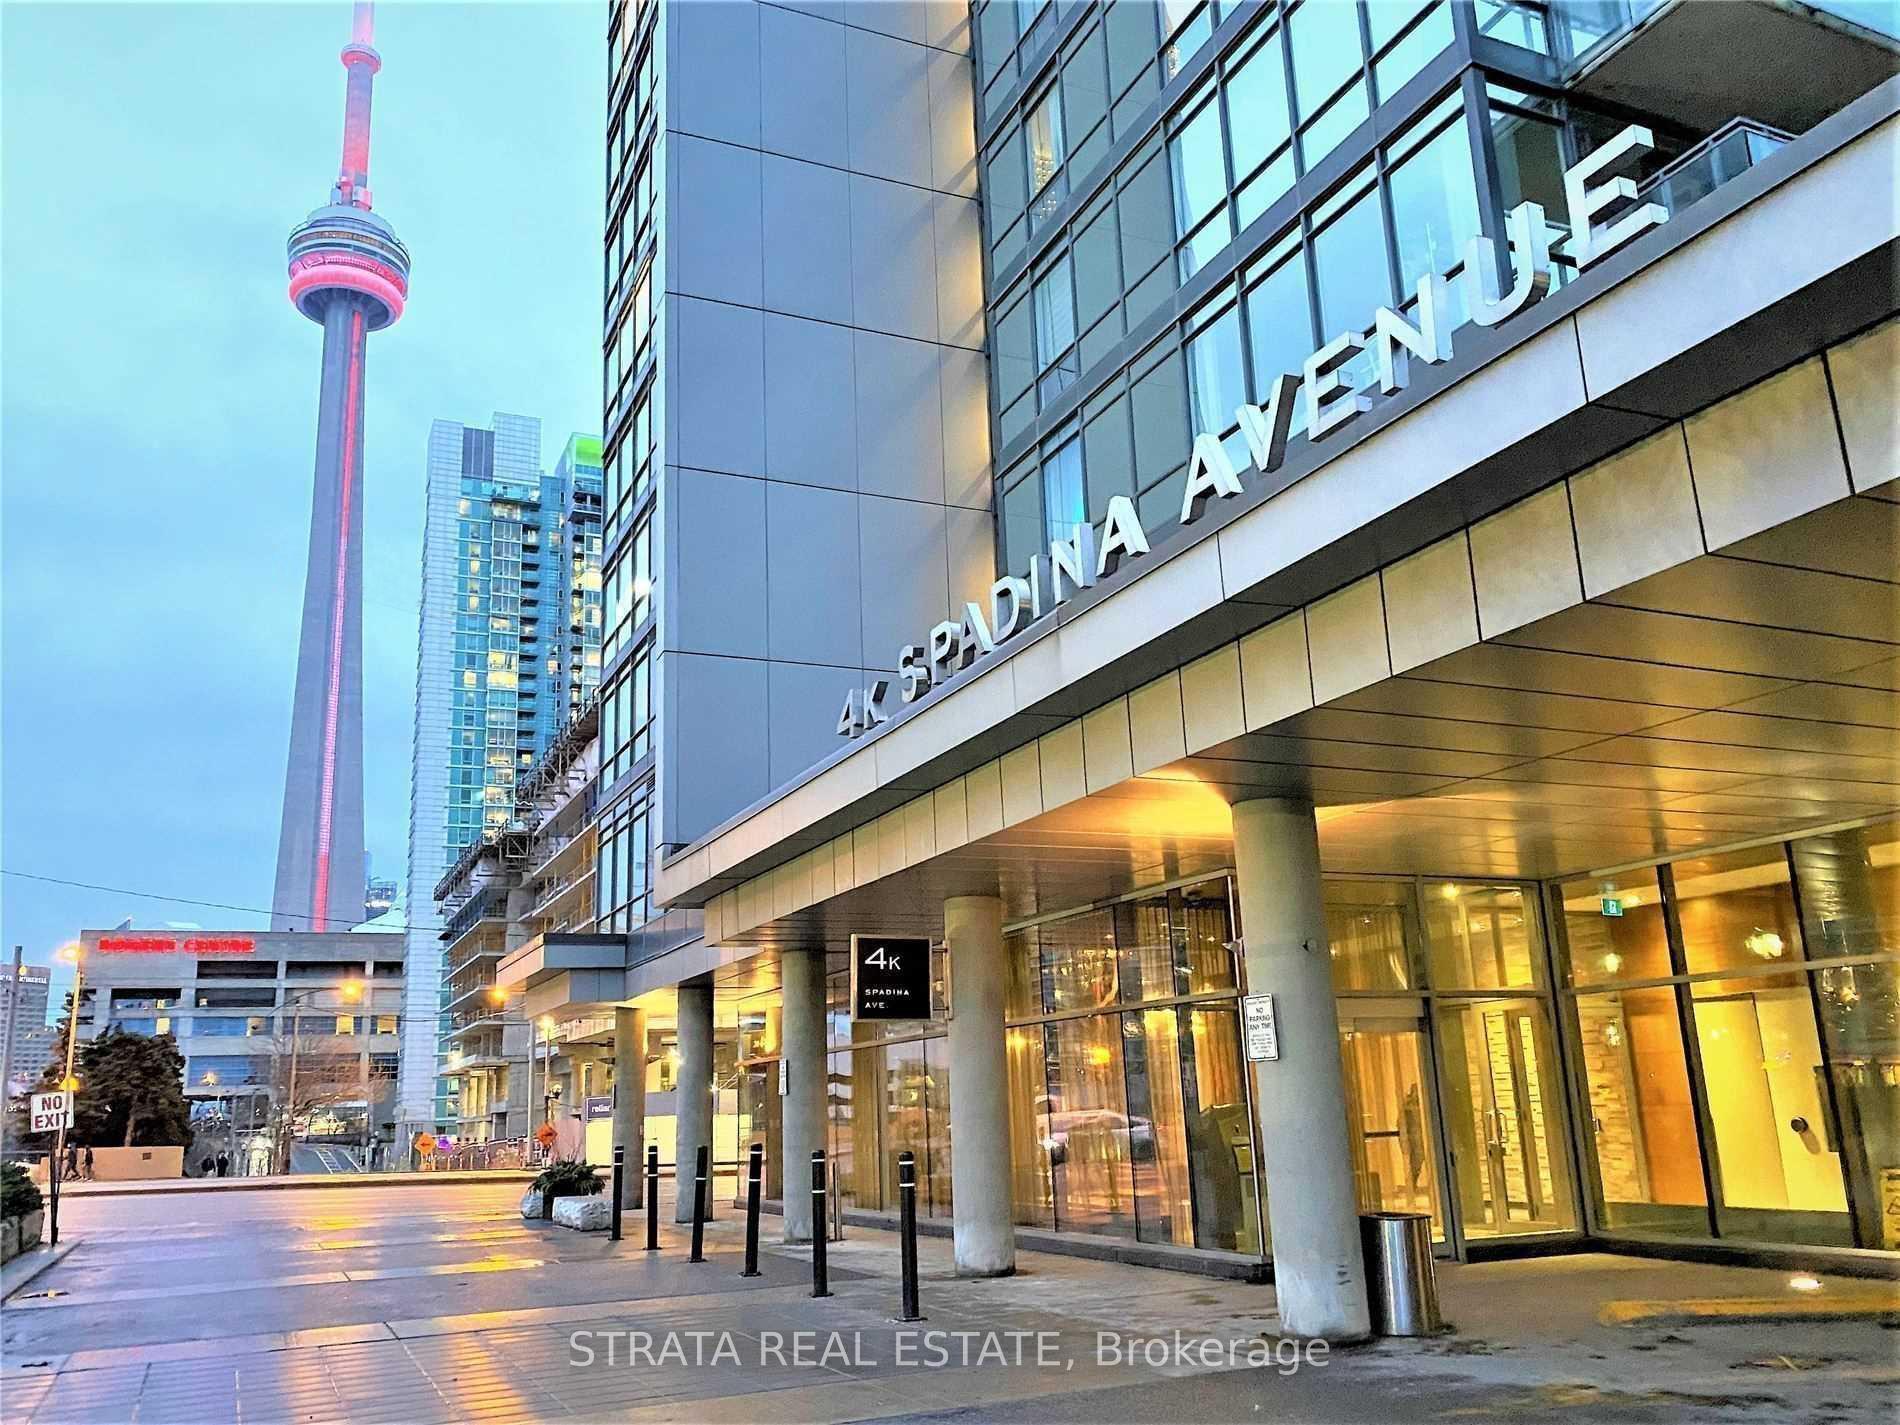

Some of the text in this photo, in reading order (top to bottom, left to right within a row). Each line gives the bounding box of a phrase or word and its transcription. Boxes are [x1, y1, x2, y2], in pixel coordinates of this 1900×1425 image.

[837, 124, 1670, 739] 4K SPADINA AVENUE
[864, 947, 901, 970] 4K
[865, 988, 910, 996] SPADINA
[41, 1095, 63, 1111] NO
[34, 1110, 70, 1129] EXIT
